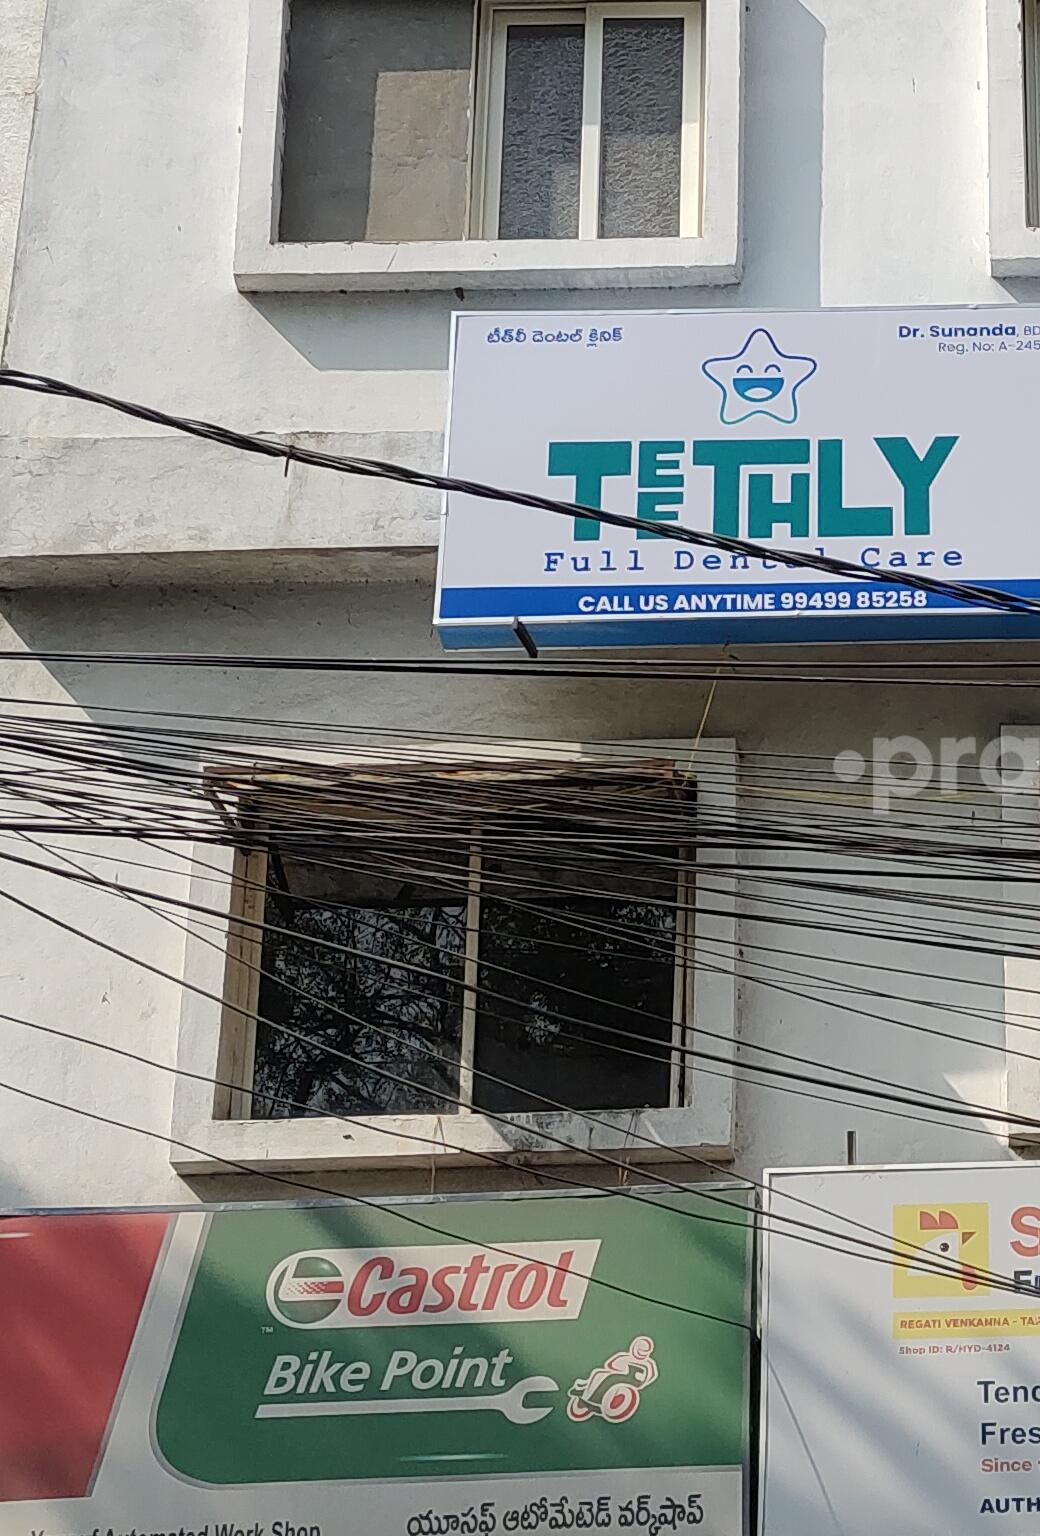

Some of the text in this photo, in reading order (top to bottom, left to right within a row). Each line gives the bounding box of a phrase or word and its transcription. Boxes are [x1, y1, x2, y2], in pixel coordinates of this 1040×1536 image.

[898, 324, 925, 339] Dr.
[929, 323, 1019, 340] Sunanda,
[938, 340, 969, 355] Reg.
[972, 340, 995, 353] No:
[543, 549, 646, 572] Full
[860, 546, 963, 570] Care
[578, 589, 928, 613] CALL US ANYTIME 99499 85258
[346, 1249, 576, 1318] Castrol
[900, 1318, 941, 1329] REGATI
[945, 1316, 1010, 1328] VENKANNA
[899, 1346, 926, 1355] Shop
[928, 1345, 943, 1354] ID:
[263, 1346, 513, 1396] Bike Point
[980, 1457, 1033, 1474] Since
